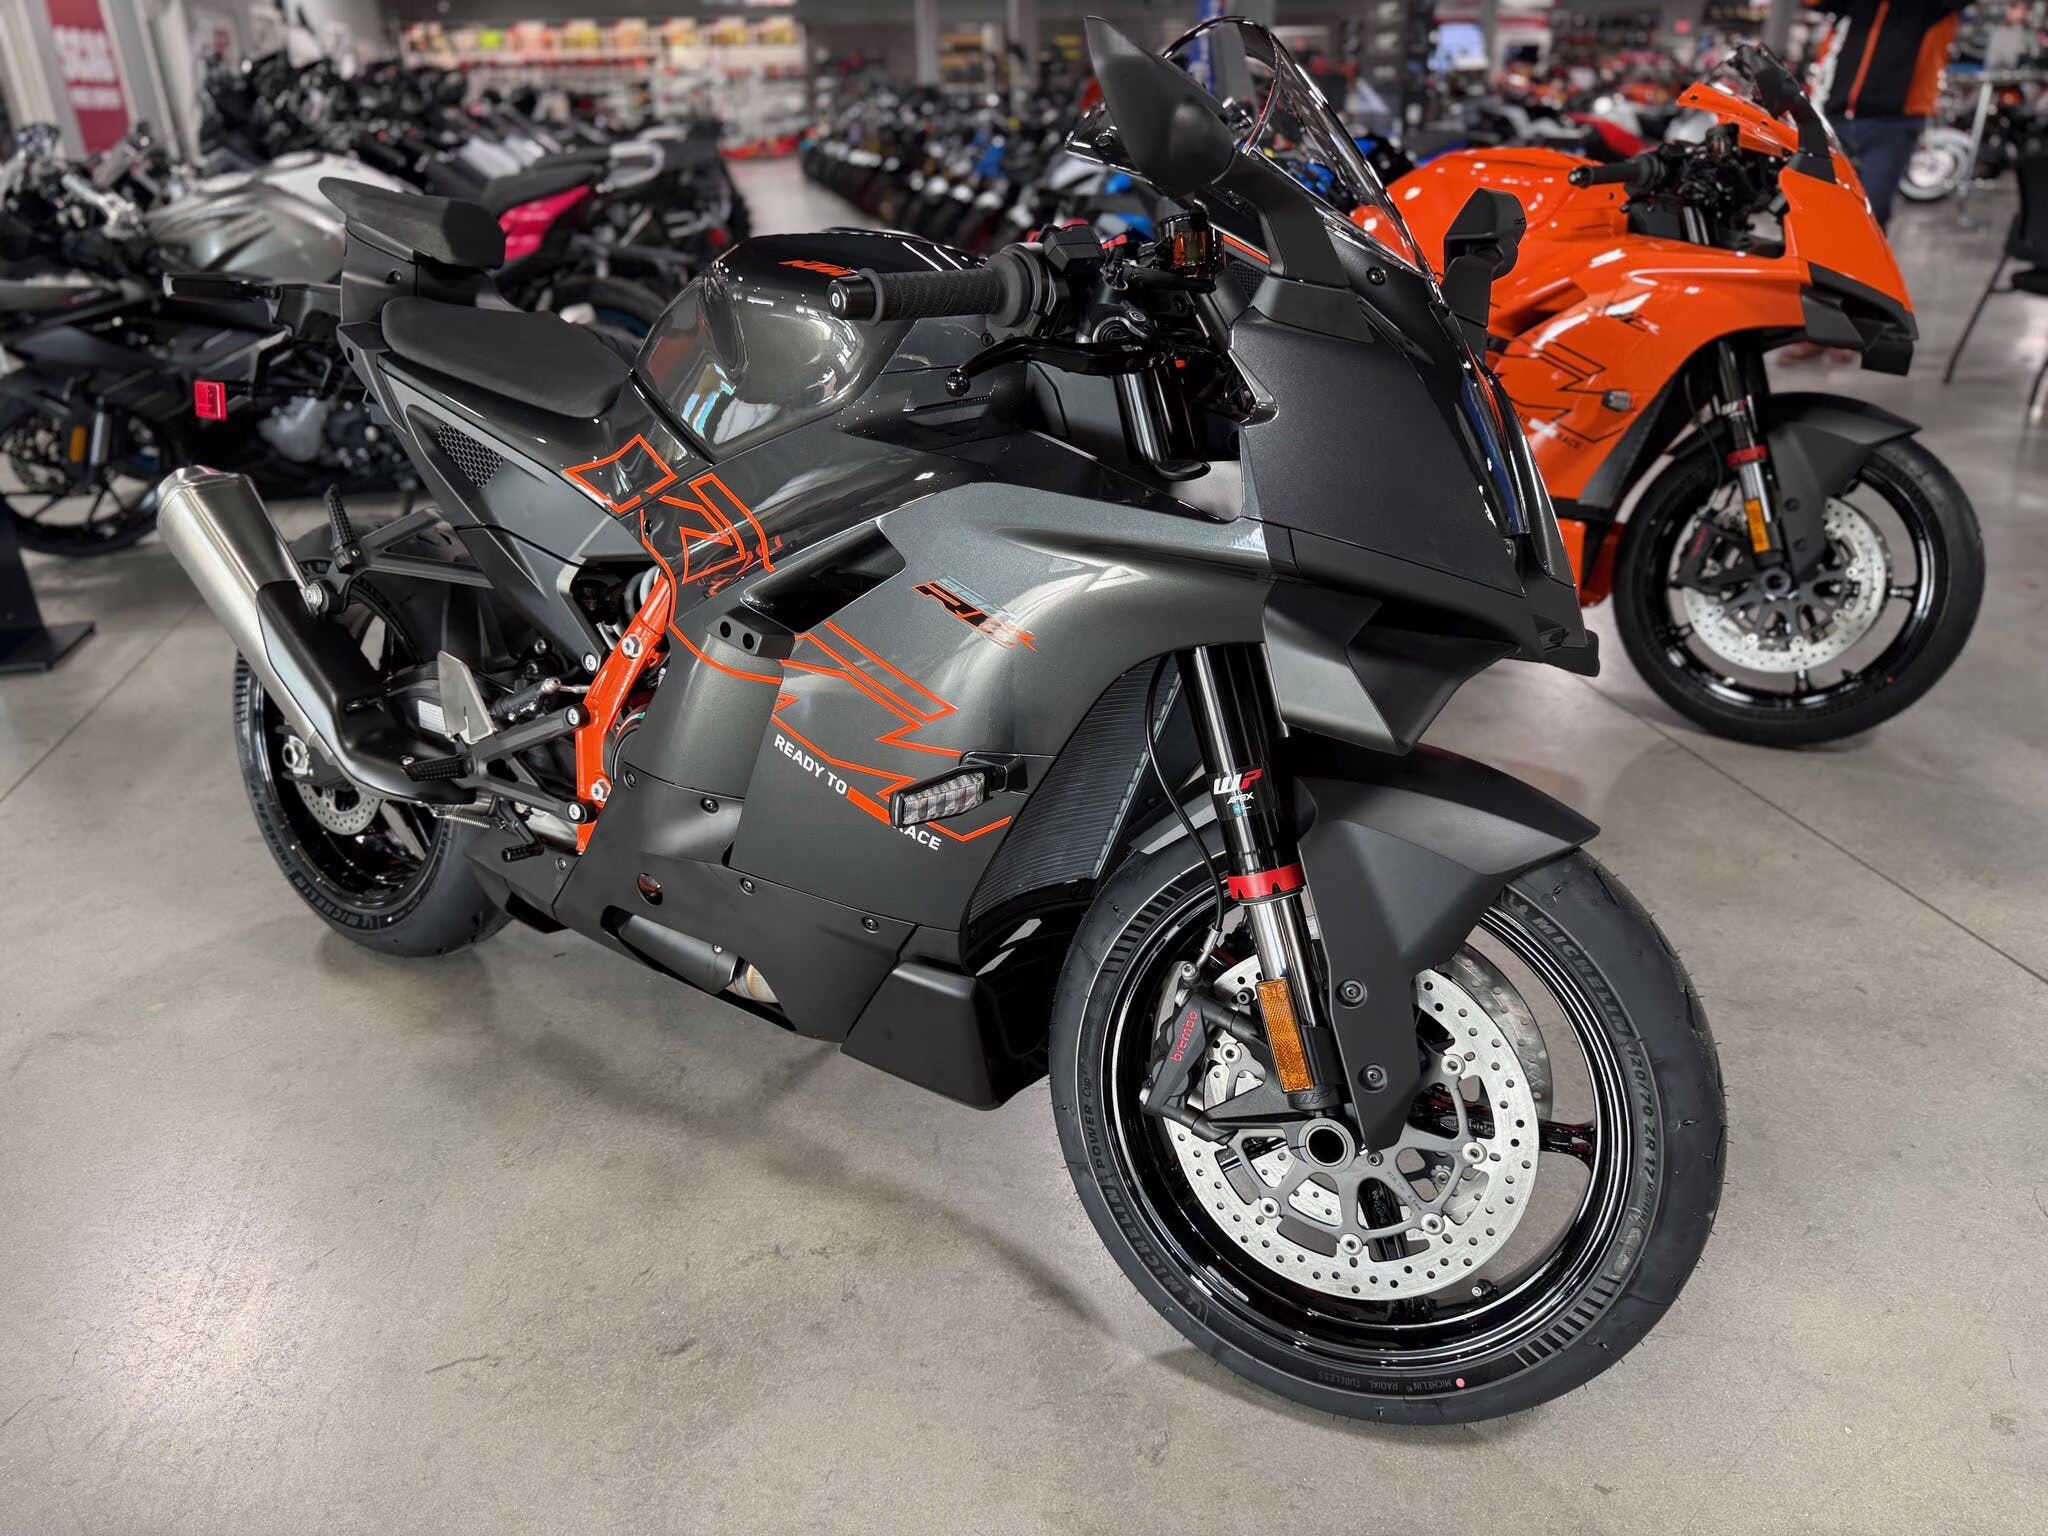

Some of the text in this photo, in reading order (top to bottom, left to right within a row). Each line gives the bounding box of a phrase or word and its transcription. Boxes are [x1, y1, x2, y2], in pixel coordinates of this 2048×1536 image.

[774, 733, 825, 778] READY
[827, 771, 848, 795] TO
[1213, 768, 1263, 795] WP
[1532, 917, 1632, 1035] MICHELIN
[1171, 1010, 1198, 1062] brembo
[1629, 1047, 1654, 1117] 120/70
[1084, 1103, 1106, 1170] POWER
[1644, 1126, 1657, 1154] ZR
[1644, 1157, 1657, 1180] 17
[1102, 1185, 1186, 1296] MICHELIN
[1317, 1371, 1361, 1388] TUBELESS
[1368, 1379, 1399, 1391] RADIAL
